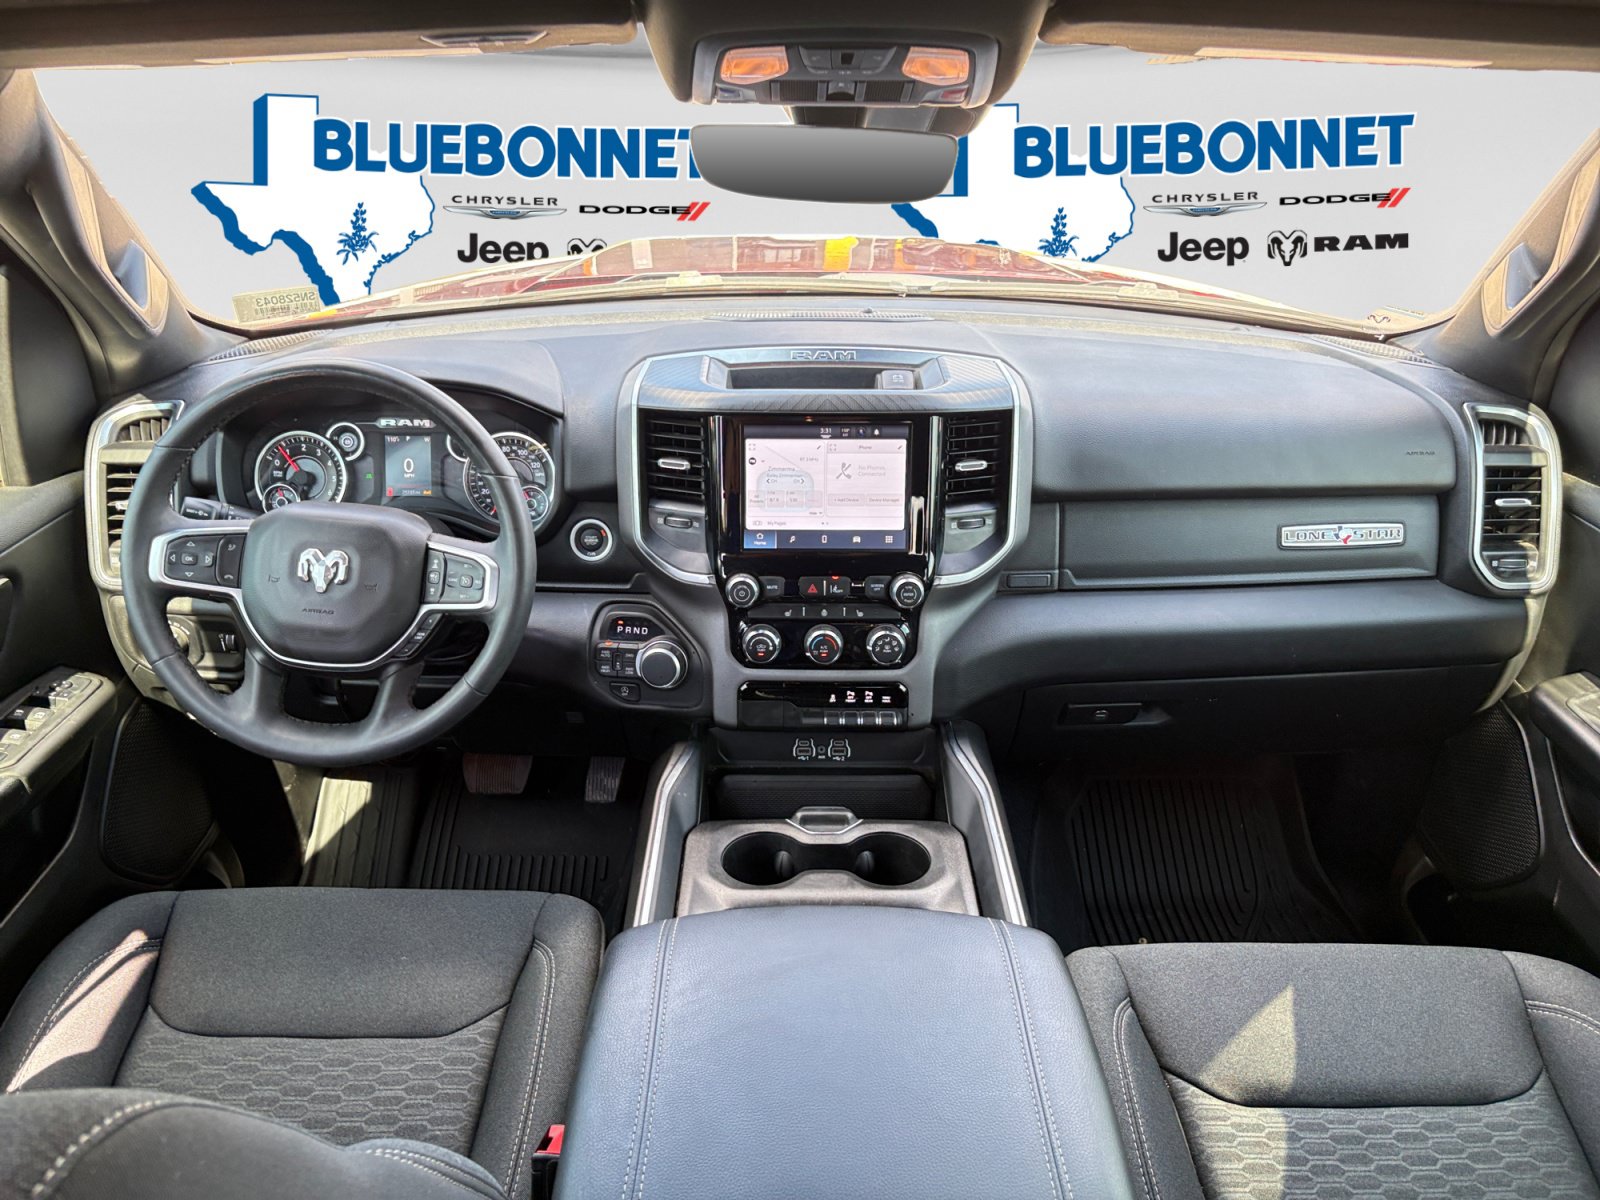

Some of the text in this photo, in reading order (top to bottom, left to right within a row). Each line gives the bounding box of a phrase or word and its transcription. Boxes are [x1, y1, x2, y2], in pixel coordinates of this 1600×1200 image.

[790, 350, 857, 360] RAM
[380, 419, 433, 427] RAM
[403, 458, 414, 473] 0
[1285, 529, 1402, 542] LONE STAR
[625, 626, 632, 634] R
[641, 627, 648, 635] D
